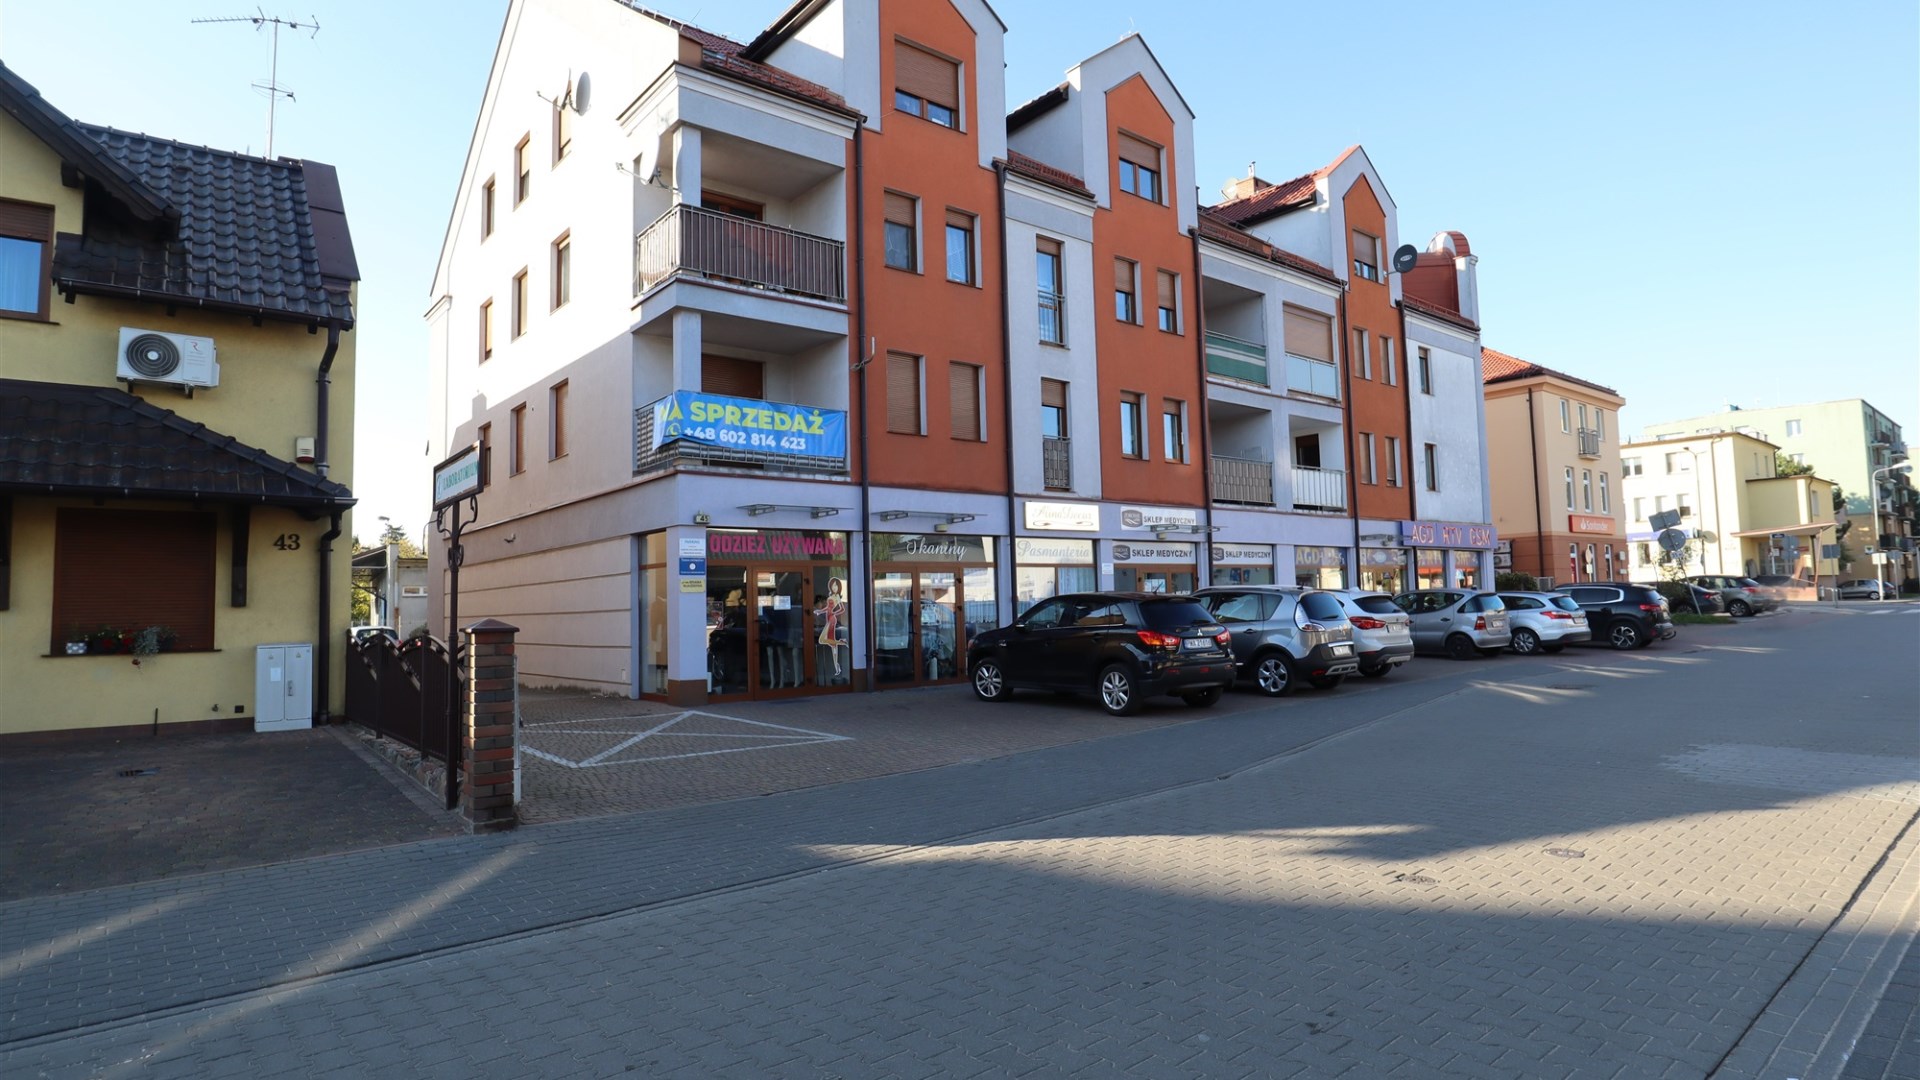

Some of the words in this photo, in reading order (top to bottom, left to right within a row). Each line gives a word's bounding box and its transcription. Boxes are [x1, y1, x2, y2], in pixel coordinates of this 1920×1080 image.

[690, 401, 825, 435] SPRZEDAŻ
[684, 427, 716, 441] +48
[719, 430, 747, 445] 602
[750, 433, 776, 447] 814
[780, 436, 806, 450] 423
[1143, 516, 1163, 524] SKLEP
[1164, 517, 1195, 525] MEDYCZNY
[272, 533, 301, 551] 43
[709, 531, 766, 554] ODZIEŻ
[770, 531, 845, 556] UŻYWANA
[1442, 526, 1463, 545] RTV
[1469, 527, 1491, 546] GSM
[1017, 540, 1090, 558] Pasmanteria
[1132, 549, 1155, 558] SKLEP
[1156, 549, 1193, 558] MEDYCZNY
[1225, 549, 1242, 558] SKLEP
[1243, 550, 1271, 559] MEDYCZNY
